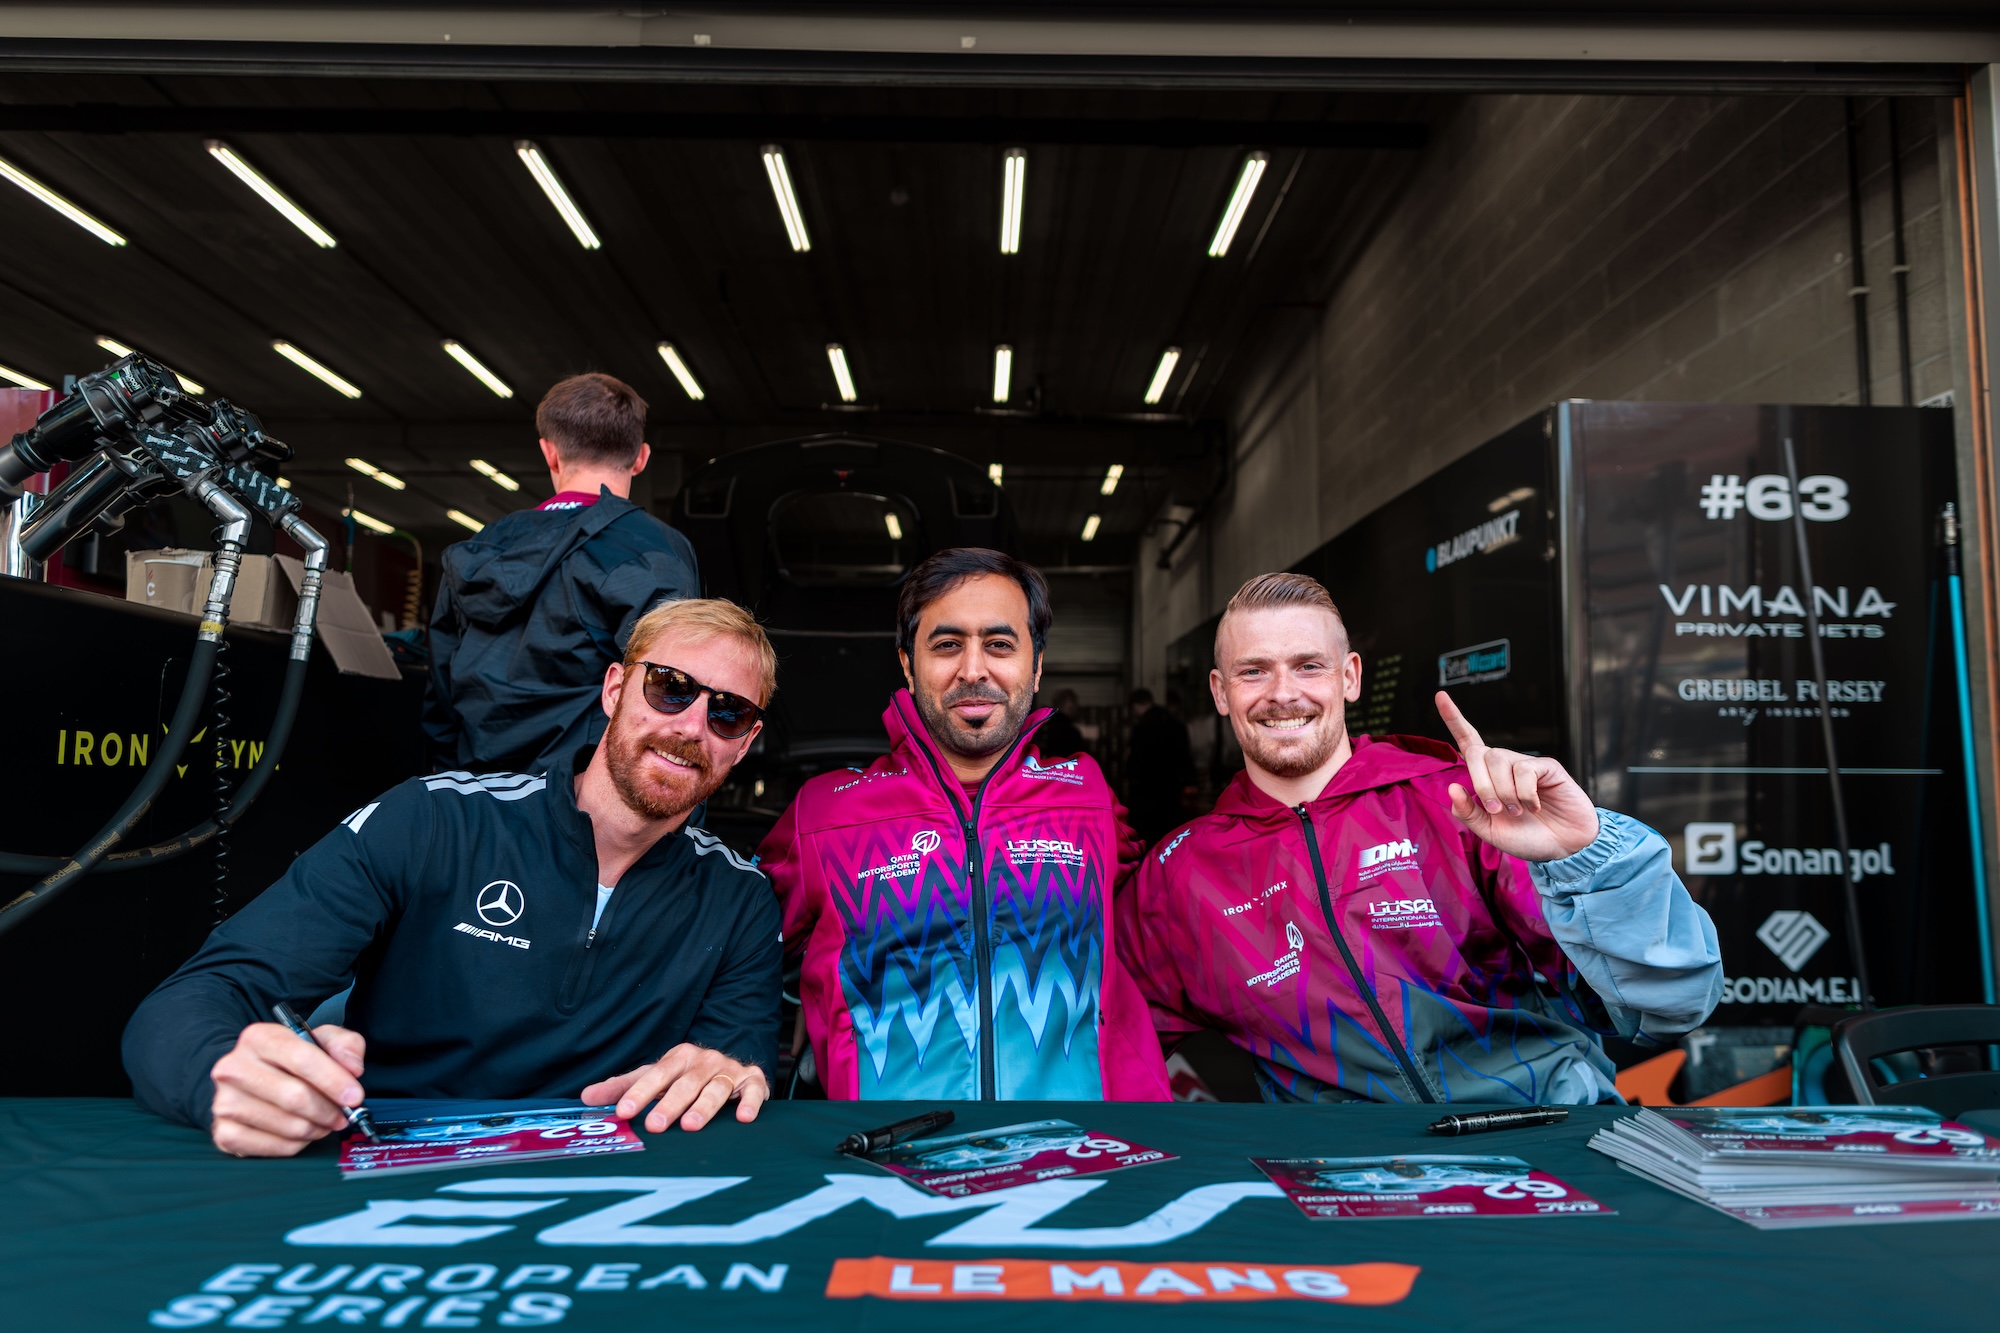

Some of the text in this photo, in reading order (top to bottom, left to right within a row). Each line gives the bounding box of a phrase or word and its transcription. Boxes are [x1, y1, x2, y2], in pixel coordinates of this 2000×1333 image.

[1701, 474, 1851, 521] #63
[1436, 509, 1520, 568] BLAUPUNKT
[1658, 584, 1898, 618] VIMANA
[1675, 622, 1806, 638] PRIVATE
[1678, 678, 1789, 702] GREUBEL
[57, 729, 149, 767] IRON
[833, 779, 860, 793] IRON
[890, 853, 920, 864] QATAR
[858, 860, 920, 879] MOTORSPORTS
[879, 867, 921, 881] ACADEMY
[1224, 880, 1288, 917] IRON LYNX
[1371, 914, 1427, 923] INTERNATIONAL
[476, 928, 531, 950] AMG
[1273, 950, 1298, 966] QATAR
[1246, 958, 1300, 987] MOTORSPORTS
[1267, 964, 1301, 988] ACADEMY
[539, 1121, 618, 1139] 62
[1894, 1129, 1986, 1147] 62
[1066, 1138, 1131, 1159] 62
[923, 1170, 985, 1187] SEASON
[1297, 1194, 1372, 1203] SEASON
[1483, 1179, 1568, 1200] 62
[200, 1262, 1350, 1298] EUROPEAN LE MANS
[147, 1291, 574, 1329] SERIES
